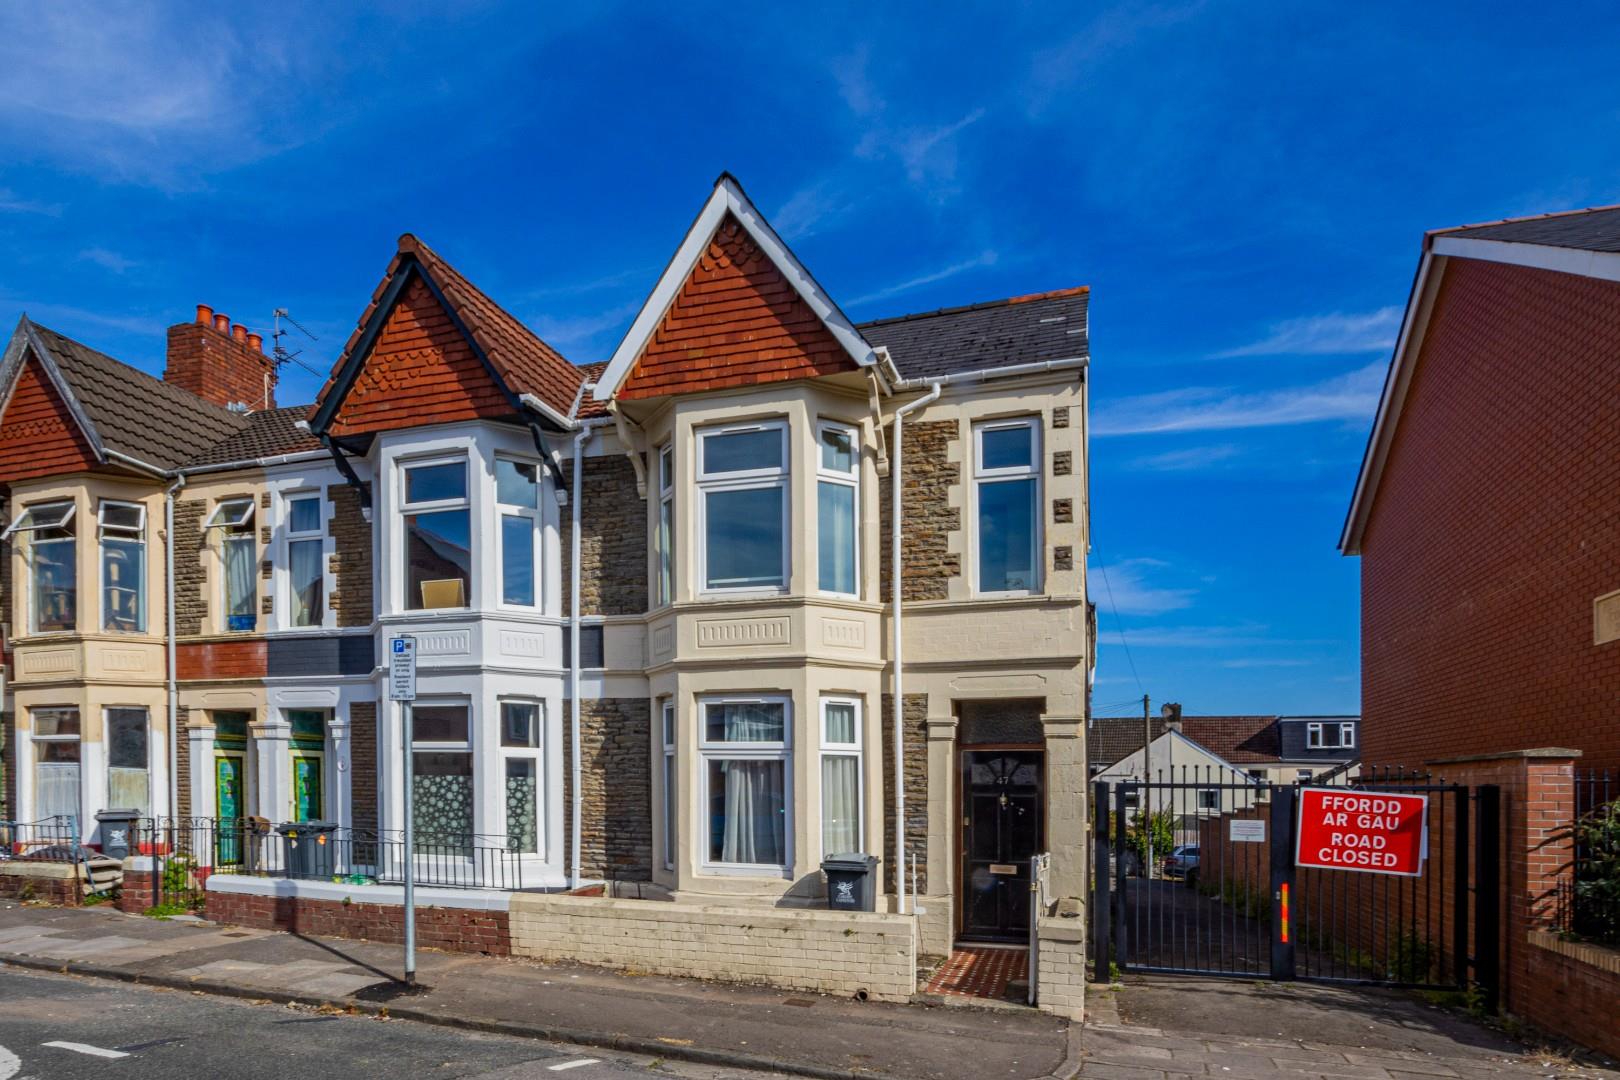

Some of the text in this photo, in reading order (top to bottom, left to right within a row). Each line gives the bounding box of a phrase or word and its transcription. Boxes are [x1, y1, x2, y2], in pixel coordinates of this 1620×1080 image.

[396, 641, 403, 652] P
[996, 776, 1009, 785] 47
[1321, 796, 1402, 815] FFORDD
[1322, 812, 1400, 831] AR GAU
[1331, 832, 1387, 850] ROAD
[1318, 847, 1398, 867] CLOSED
